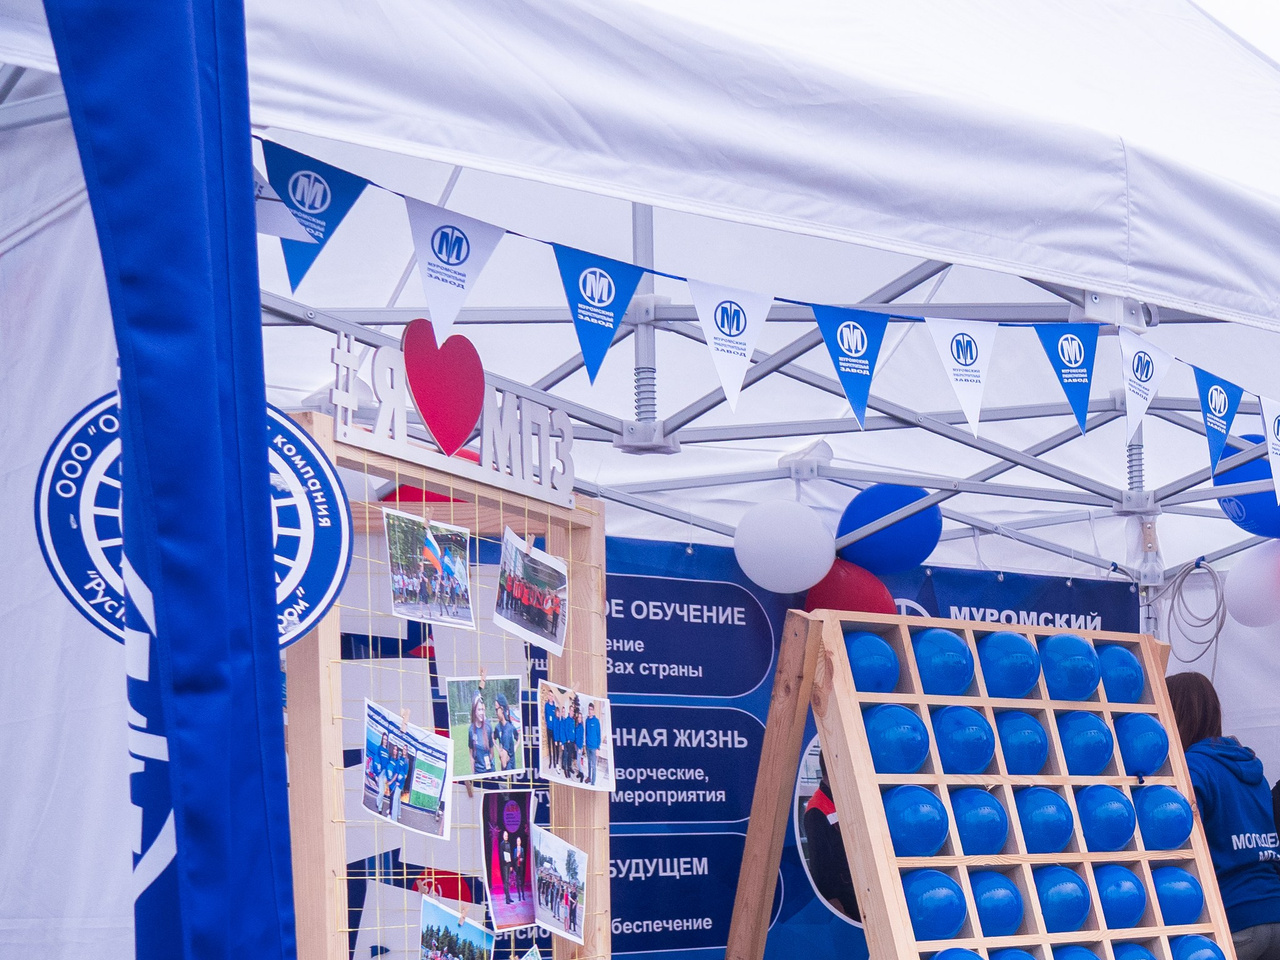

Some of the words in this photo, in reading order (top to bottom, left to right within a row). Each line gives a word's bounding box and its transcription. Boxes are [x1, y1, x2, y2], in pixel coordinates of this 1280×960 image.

[577, 313, 614, 329] ЗАВОД
[714, 346, 747, 358] ЗАВОД
[479, 386, 575, 495] МПЗ
[55, 442, 92, 498] ООО
[630, 600, 747, 626] ОБУЧЕНИЕ
[949, 605, 1102, 631] МУРОМСКИЙ
[639, 662, 703, 680] страны
[673, 729, 749, 749] ЖИЗНЬ
[611, 790, 726, 806] мероприятия
